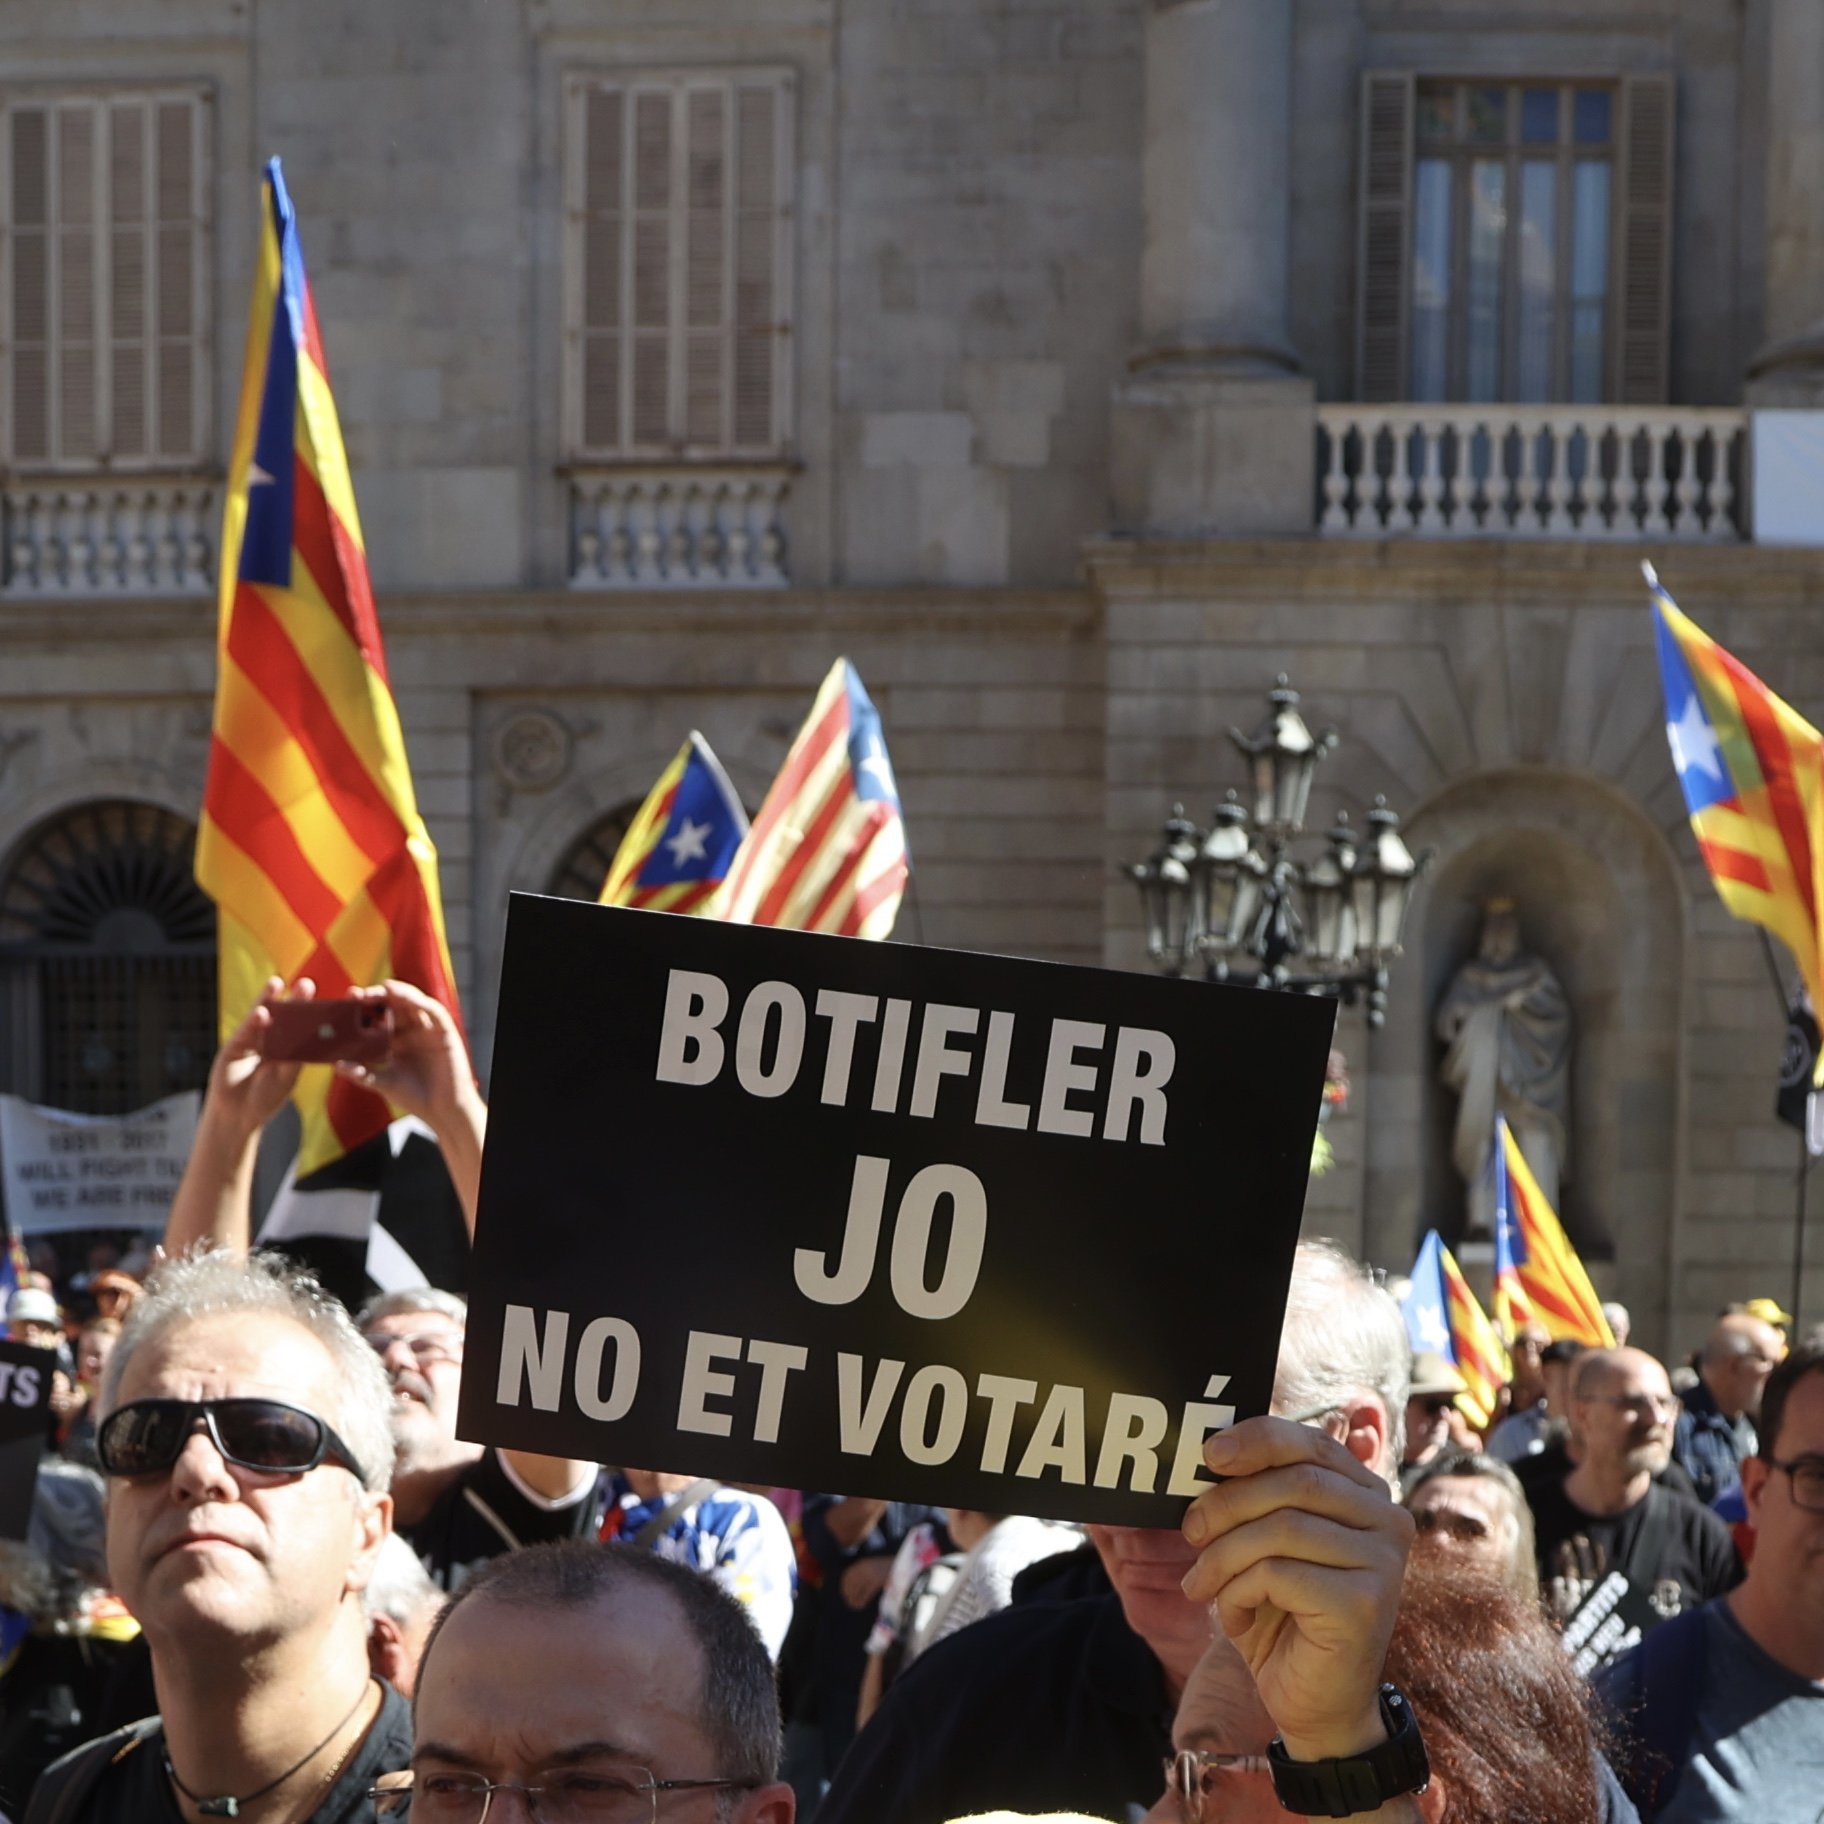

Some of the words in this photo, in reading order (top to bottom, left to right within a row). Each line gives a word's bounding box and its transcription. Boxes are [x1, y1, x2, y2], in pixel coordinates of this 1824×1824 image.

[655, 968, 1177, 1147] BOTIFLER
[793, 1154, 988, 1321] JO
[496, 1303, 641, 1423] NO
[676, 1330, 809, 1445] ET
[836, 1351, 1237, 1497] VOTARÉ
